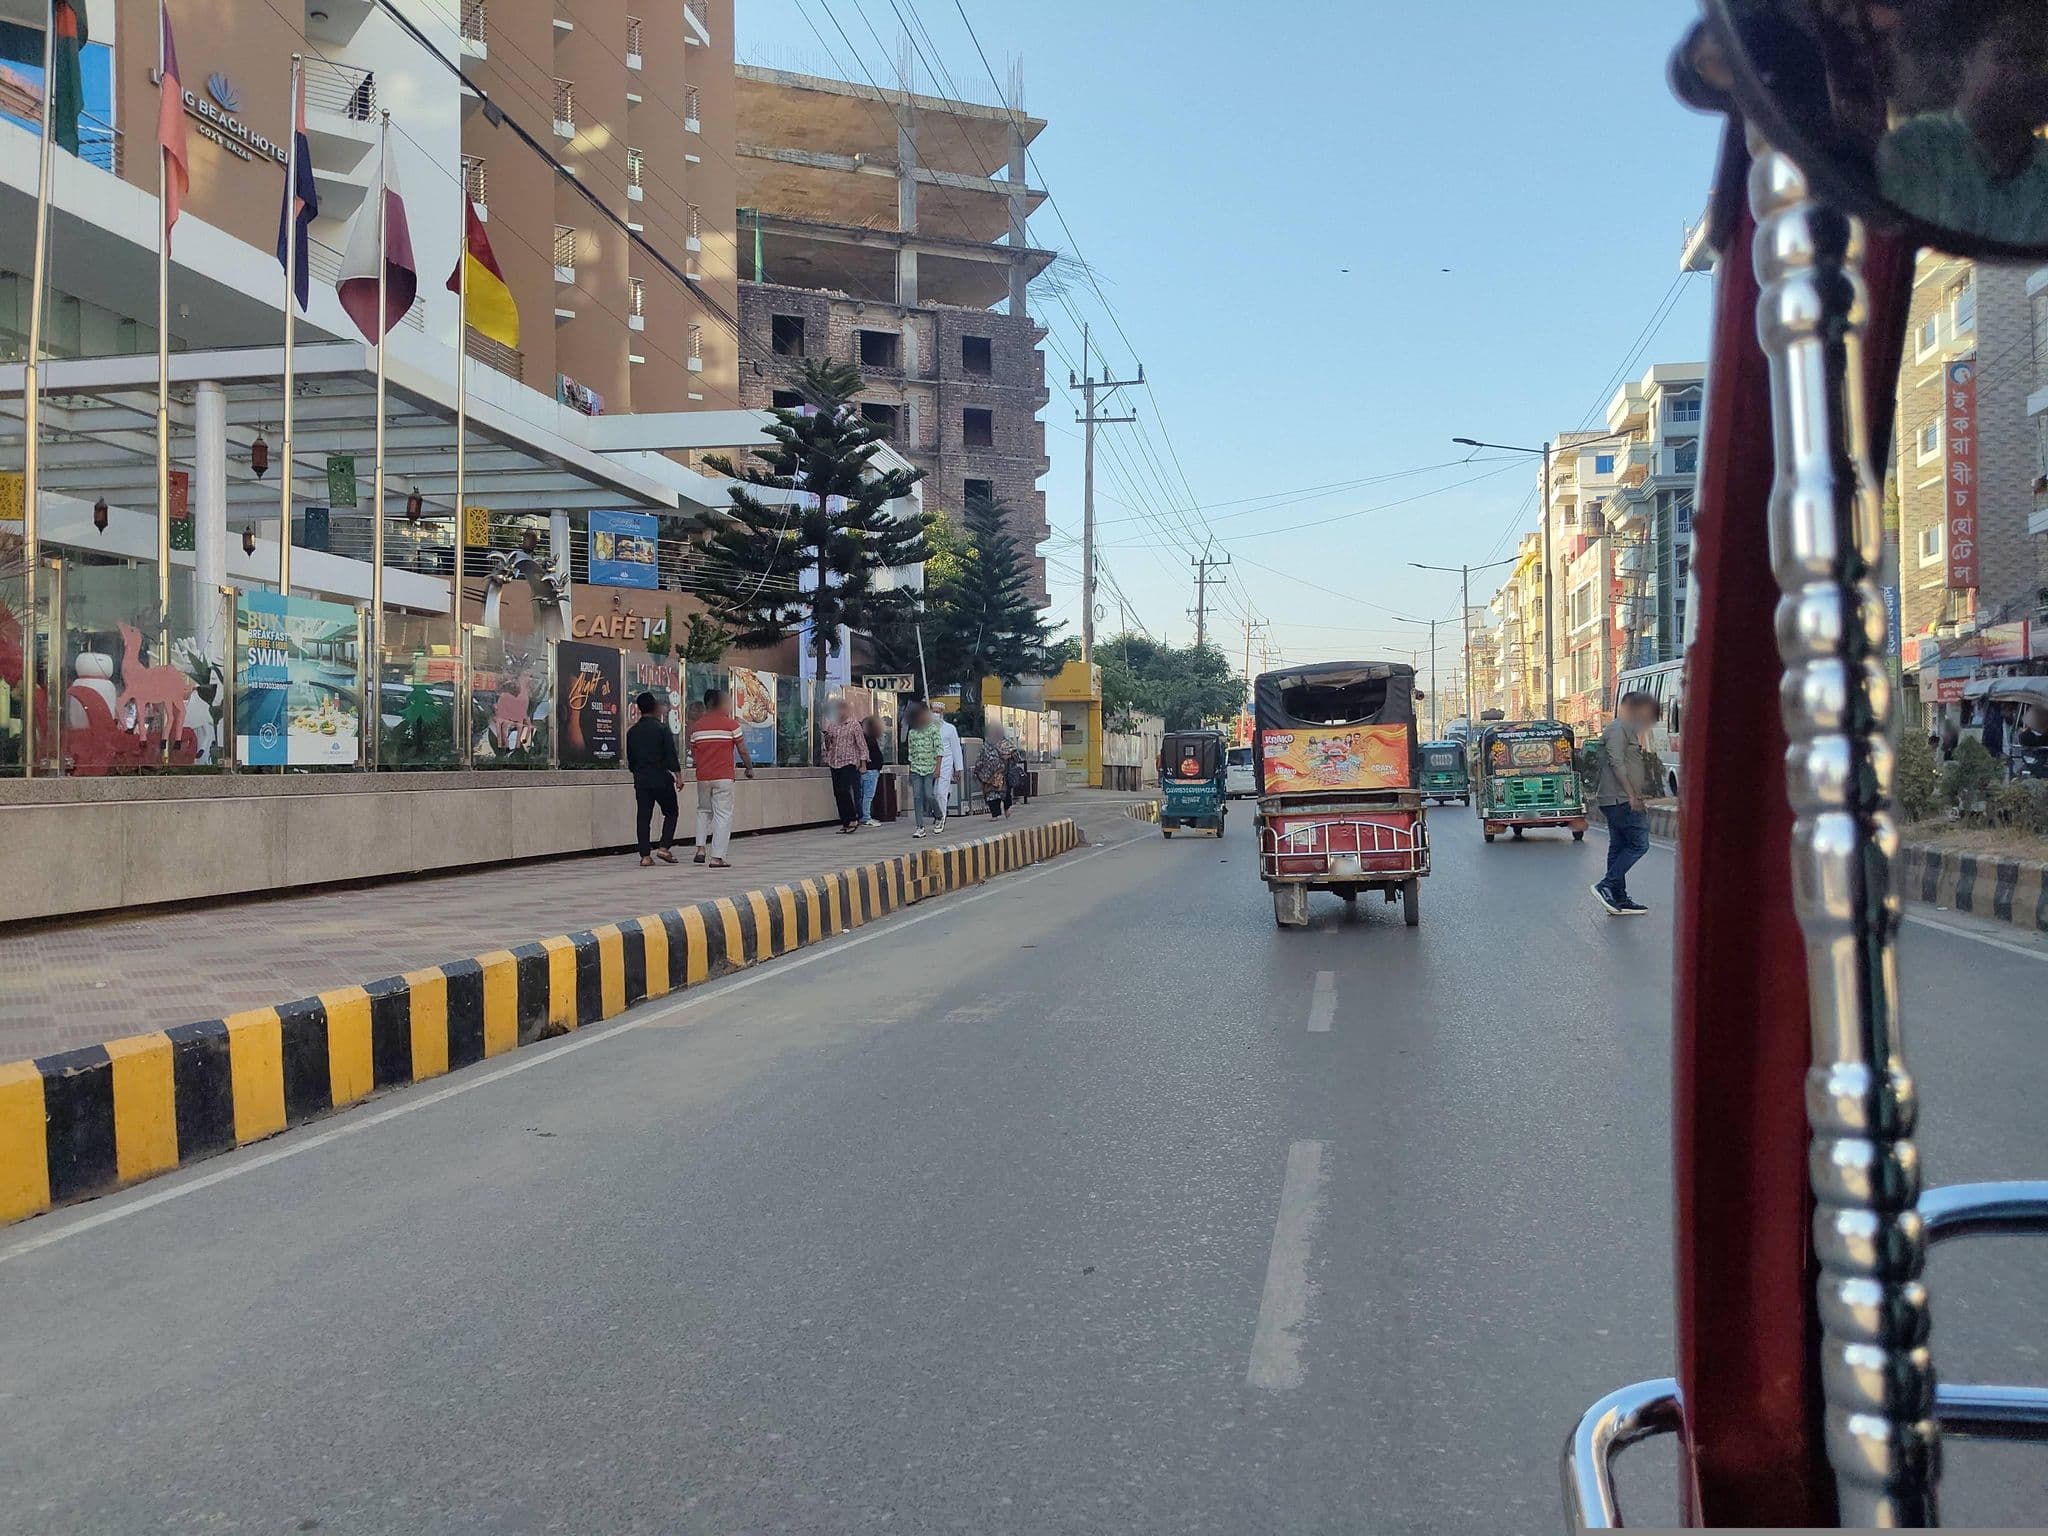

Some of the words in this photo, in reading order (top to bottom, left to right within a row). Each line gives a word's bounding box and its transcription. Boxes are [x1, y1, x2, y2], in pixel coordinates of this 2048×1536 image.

[200, 99, 247, 139] BEACH
[227, 141, 252, 161] BAZAR
[1952, 518, 1973, 583] হোটেল
[573, 609, 637, 639] CAFÉ
[642, 618, 667, 639] 14
[248, 629, 288, 642] BREAKFAST
[259, 640, 271, 649] FREE
[248, 648, 289, 667] SWIM
[636, 663, 672, 688] MERRY
[866, 678, 897, 690] OUT
[569, 671, 604, 710] Night
[1264, 734, 1294, 745] KRAKO
